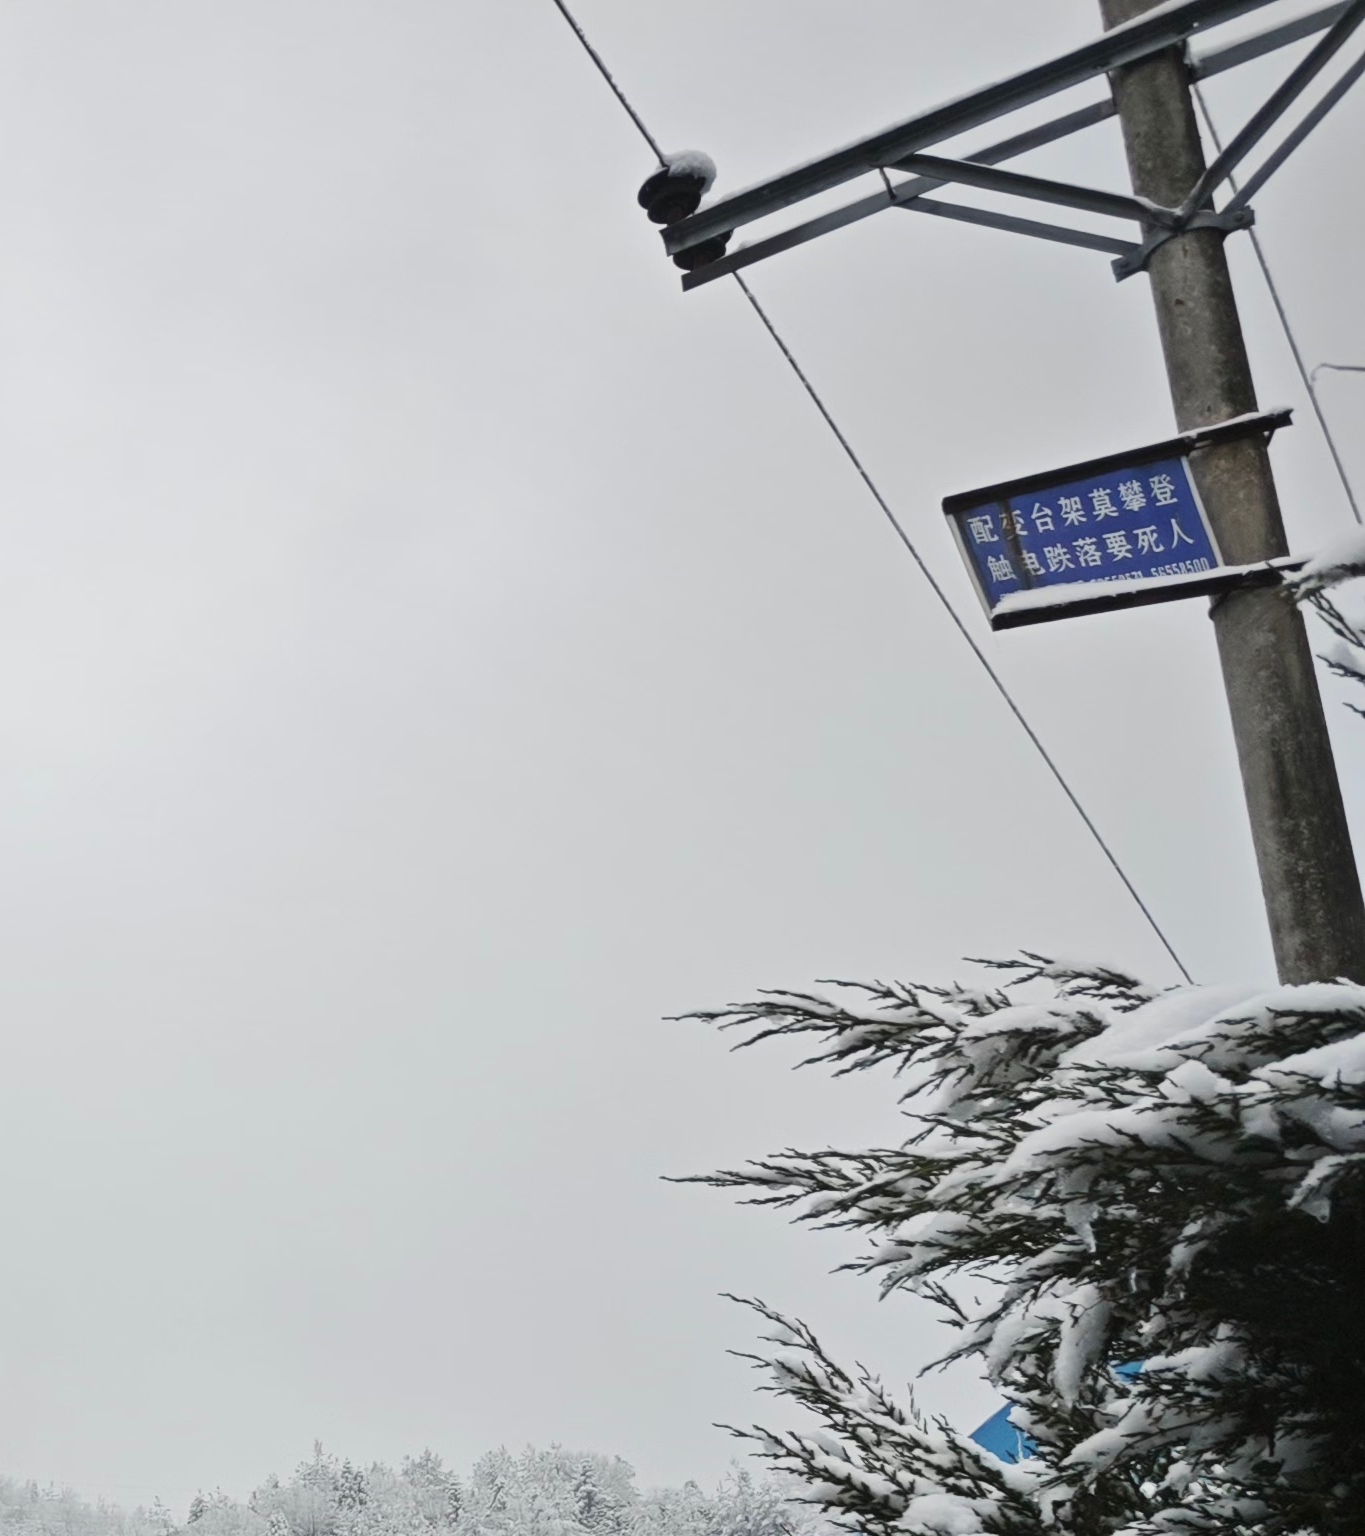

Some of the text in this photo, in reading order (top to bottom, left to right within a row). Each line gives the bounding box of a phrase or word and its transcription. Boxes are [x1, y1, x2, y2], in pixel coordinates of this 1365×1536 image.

[967, 474, 1179, 545] 配变台架莫攀登
[986, 518, 1195, 584] 触电跌落要死人
